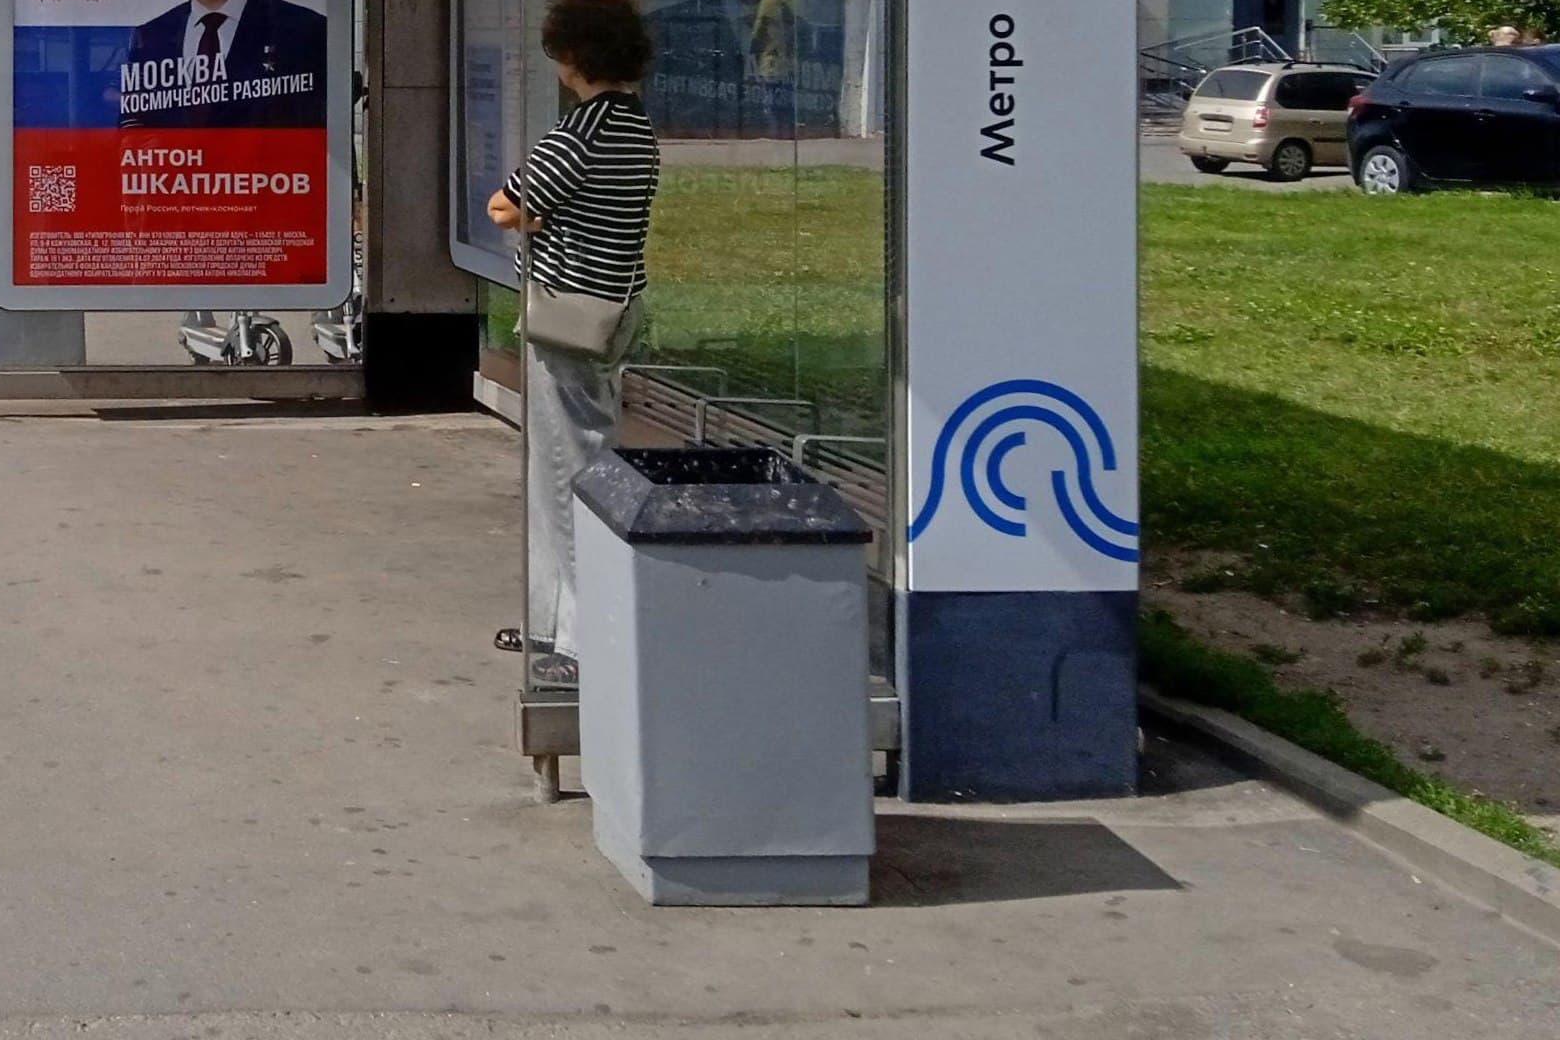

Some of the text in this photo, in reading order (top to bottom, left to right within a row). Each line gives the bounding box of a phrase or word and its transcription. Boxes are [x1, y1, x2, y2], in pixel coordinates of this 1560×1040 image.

[121, 52, 228, 93] МОСКВА
[121, 72, 314, 114] КОСМИЧЕСКОЕ РАЗВИТИЕ!
[980, 12, 1023, 166] Метро
[121, 149, 203, 166] АНТОН
[121, 173, 310, 194] ШКАПЛЕРОВ
